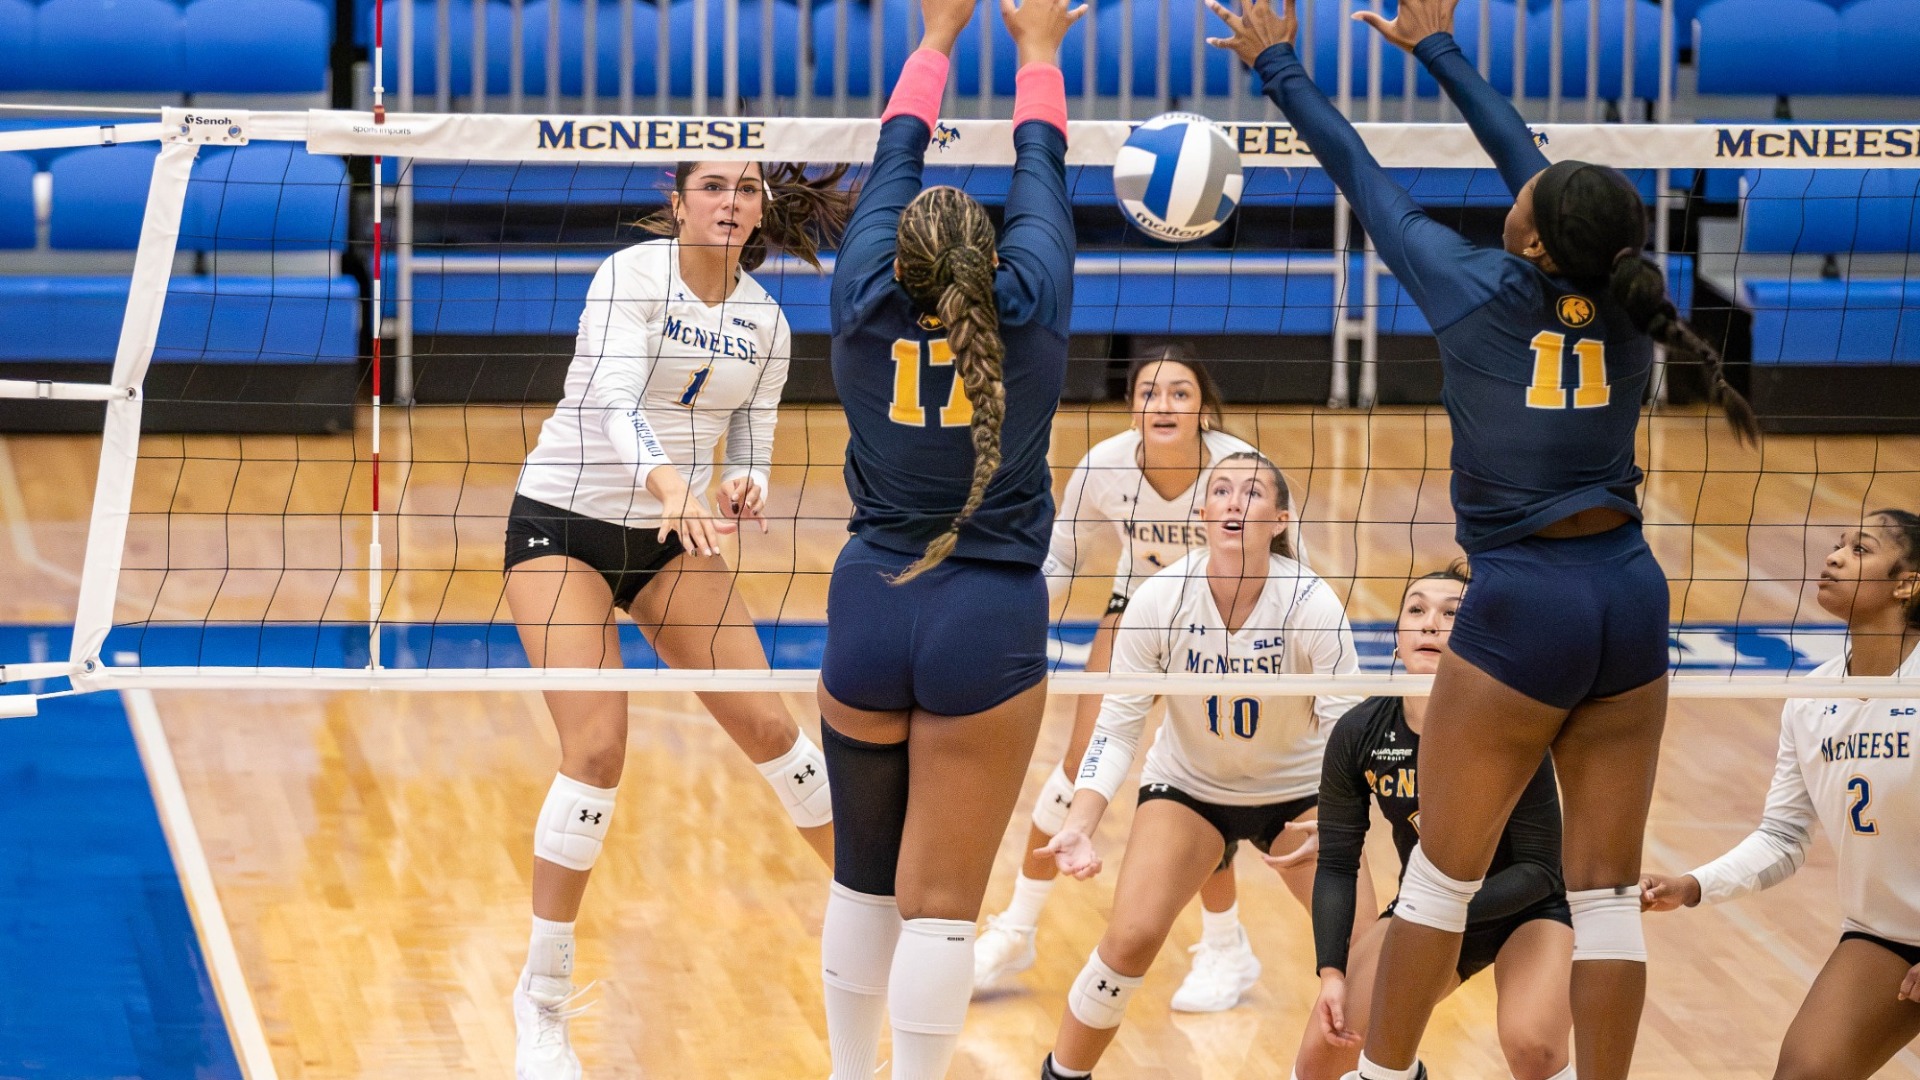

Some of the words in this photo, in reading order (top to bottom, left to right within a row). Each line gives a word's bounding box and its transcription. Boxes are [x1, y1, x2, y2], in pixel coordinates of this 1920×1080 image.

[195, 116, 232, 125] Senoh
[537, 119, 765, 150] McNEESE
[1716, 128, 1920, 157] McNEES
[1136, 211, 1204, 237] molten
[663, 315, 758, 365] McNEESE
[1525, 329, 1612, 410] 11
[675, 363, 714, 409] 1
[1123, 519, 1207, 546] McNEES
[1253, 636, 1284, 650] SLC
[1202, 695, 1263, 741] 10
[1821, 731, 1910, 762] McNEESE
[1846, 774, 1879, 836] 2
